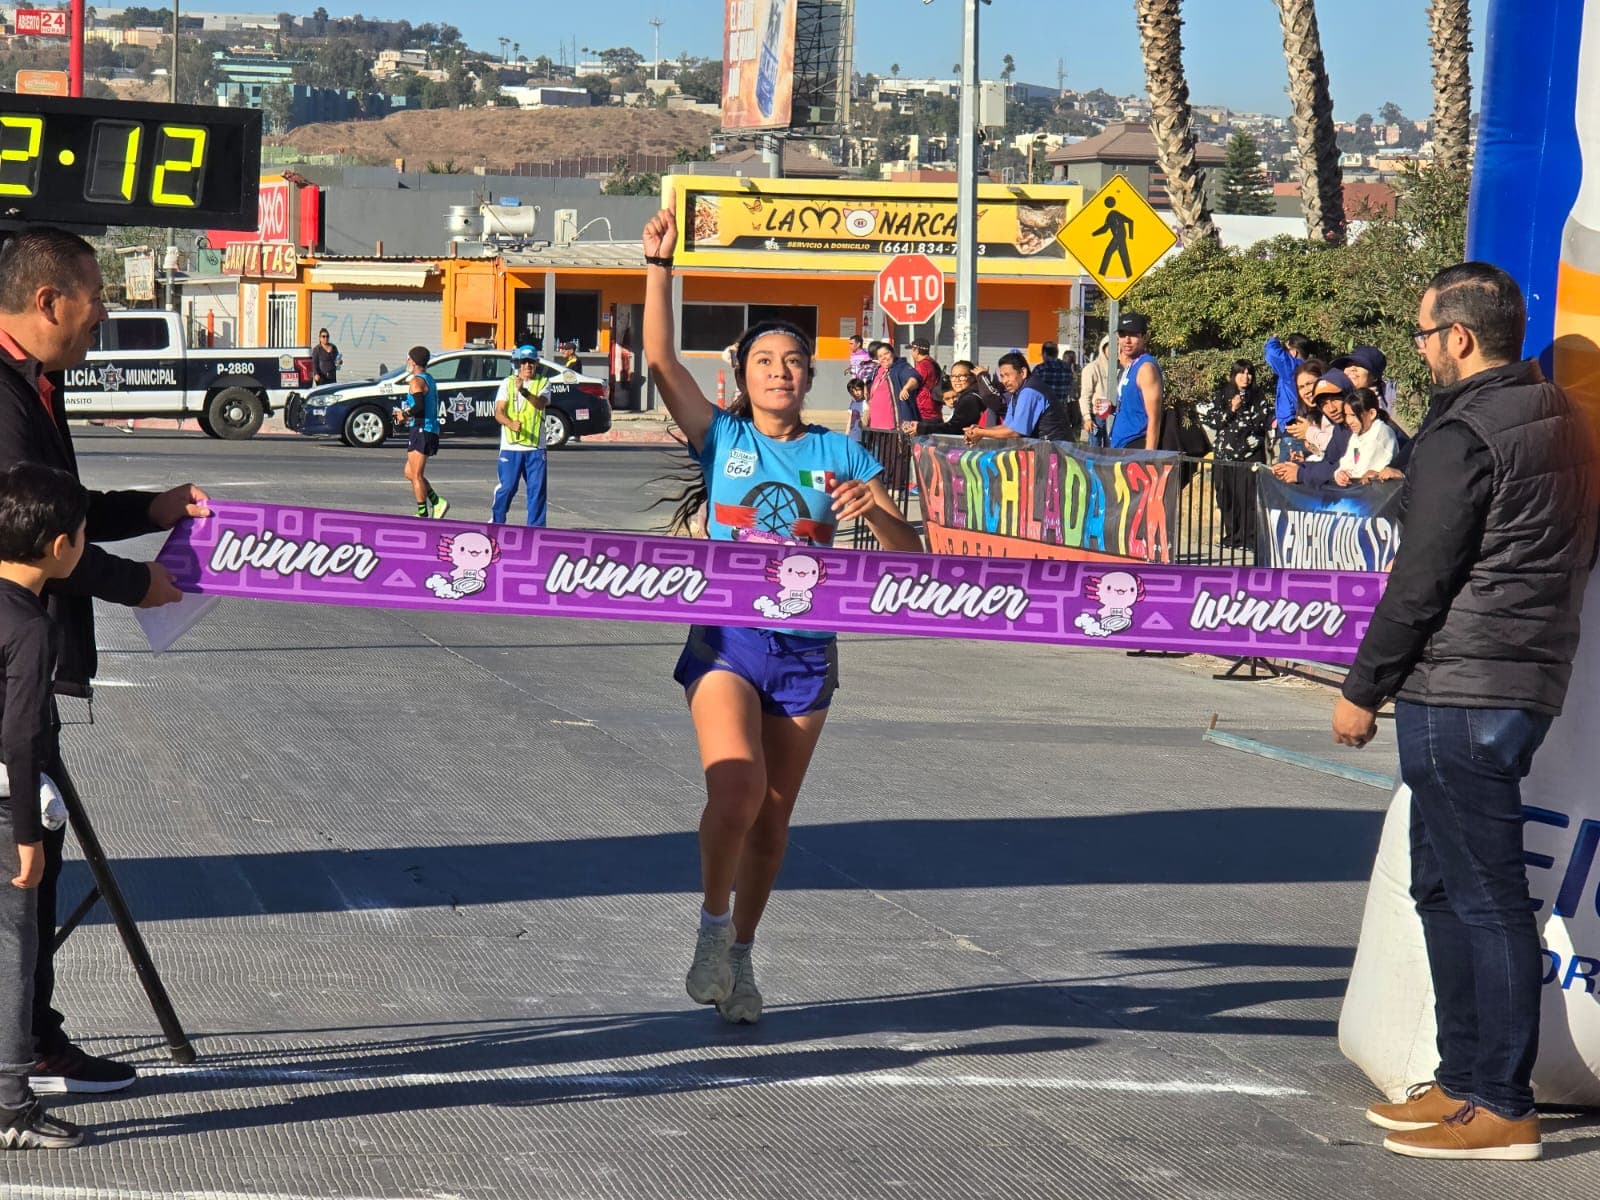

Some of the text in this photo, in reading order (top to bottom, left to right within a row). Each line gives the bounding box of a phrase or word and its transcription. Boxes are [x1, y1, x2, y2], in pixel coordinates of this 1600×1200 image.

[18, 14, 40, 31] ABIERTO
[41, 13, 64, 27] 24
[766, 208, 795, 233] LA
[787, 241, 822, 249] SERVICIO
[831, 242, 870, 250] DOMICILIO
[879, 241, 986, 256] (664) 834-73
[883, 274, 940, 302] ALTO
[217, 362, 255, 374] P-2880
[64, 367, 176, 386] LICÍA MUNICIPAL
[726, 462, 752, 476] 664
[1282, 510, 1368, 571] ENCHILADA
